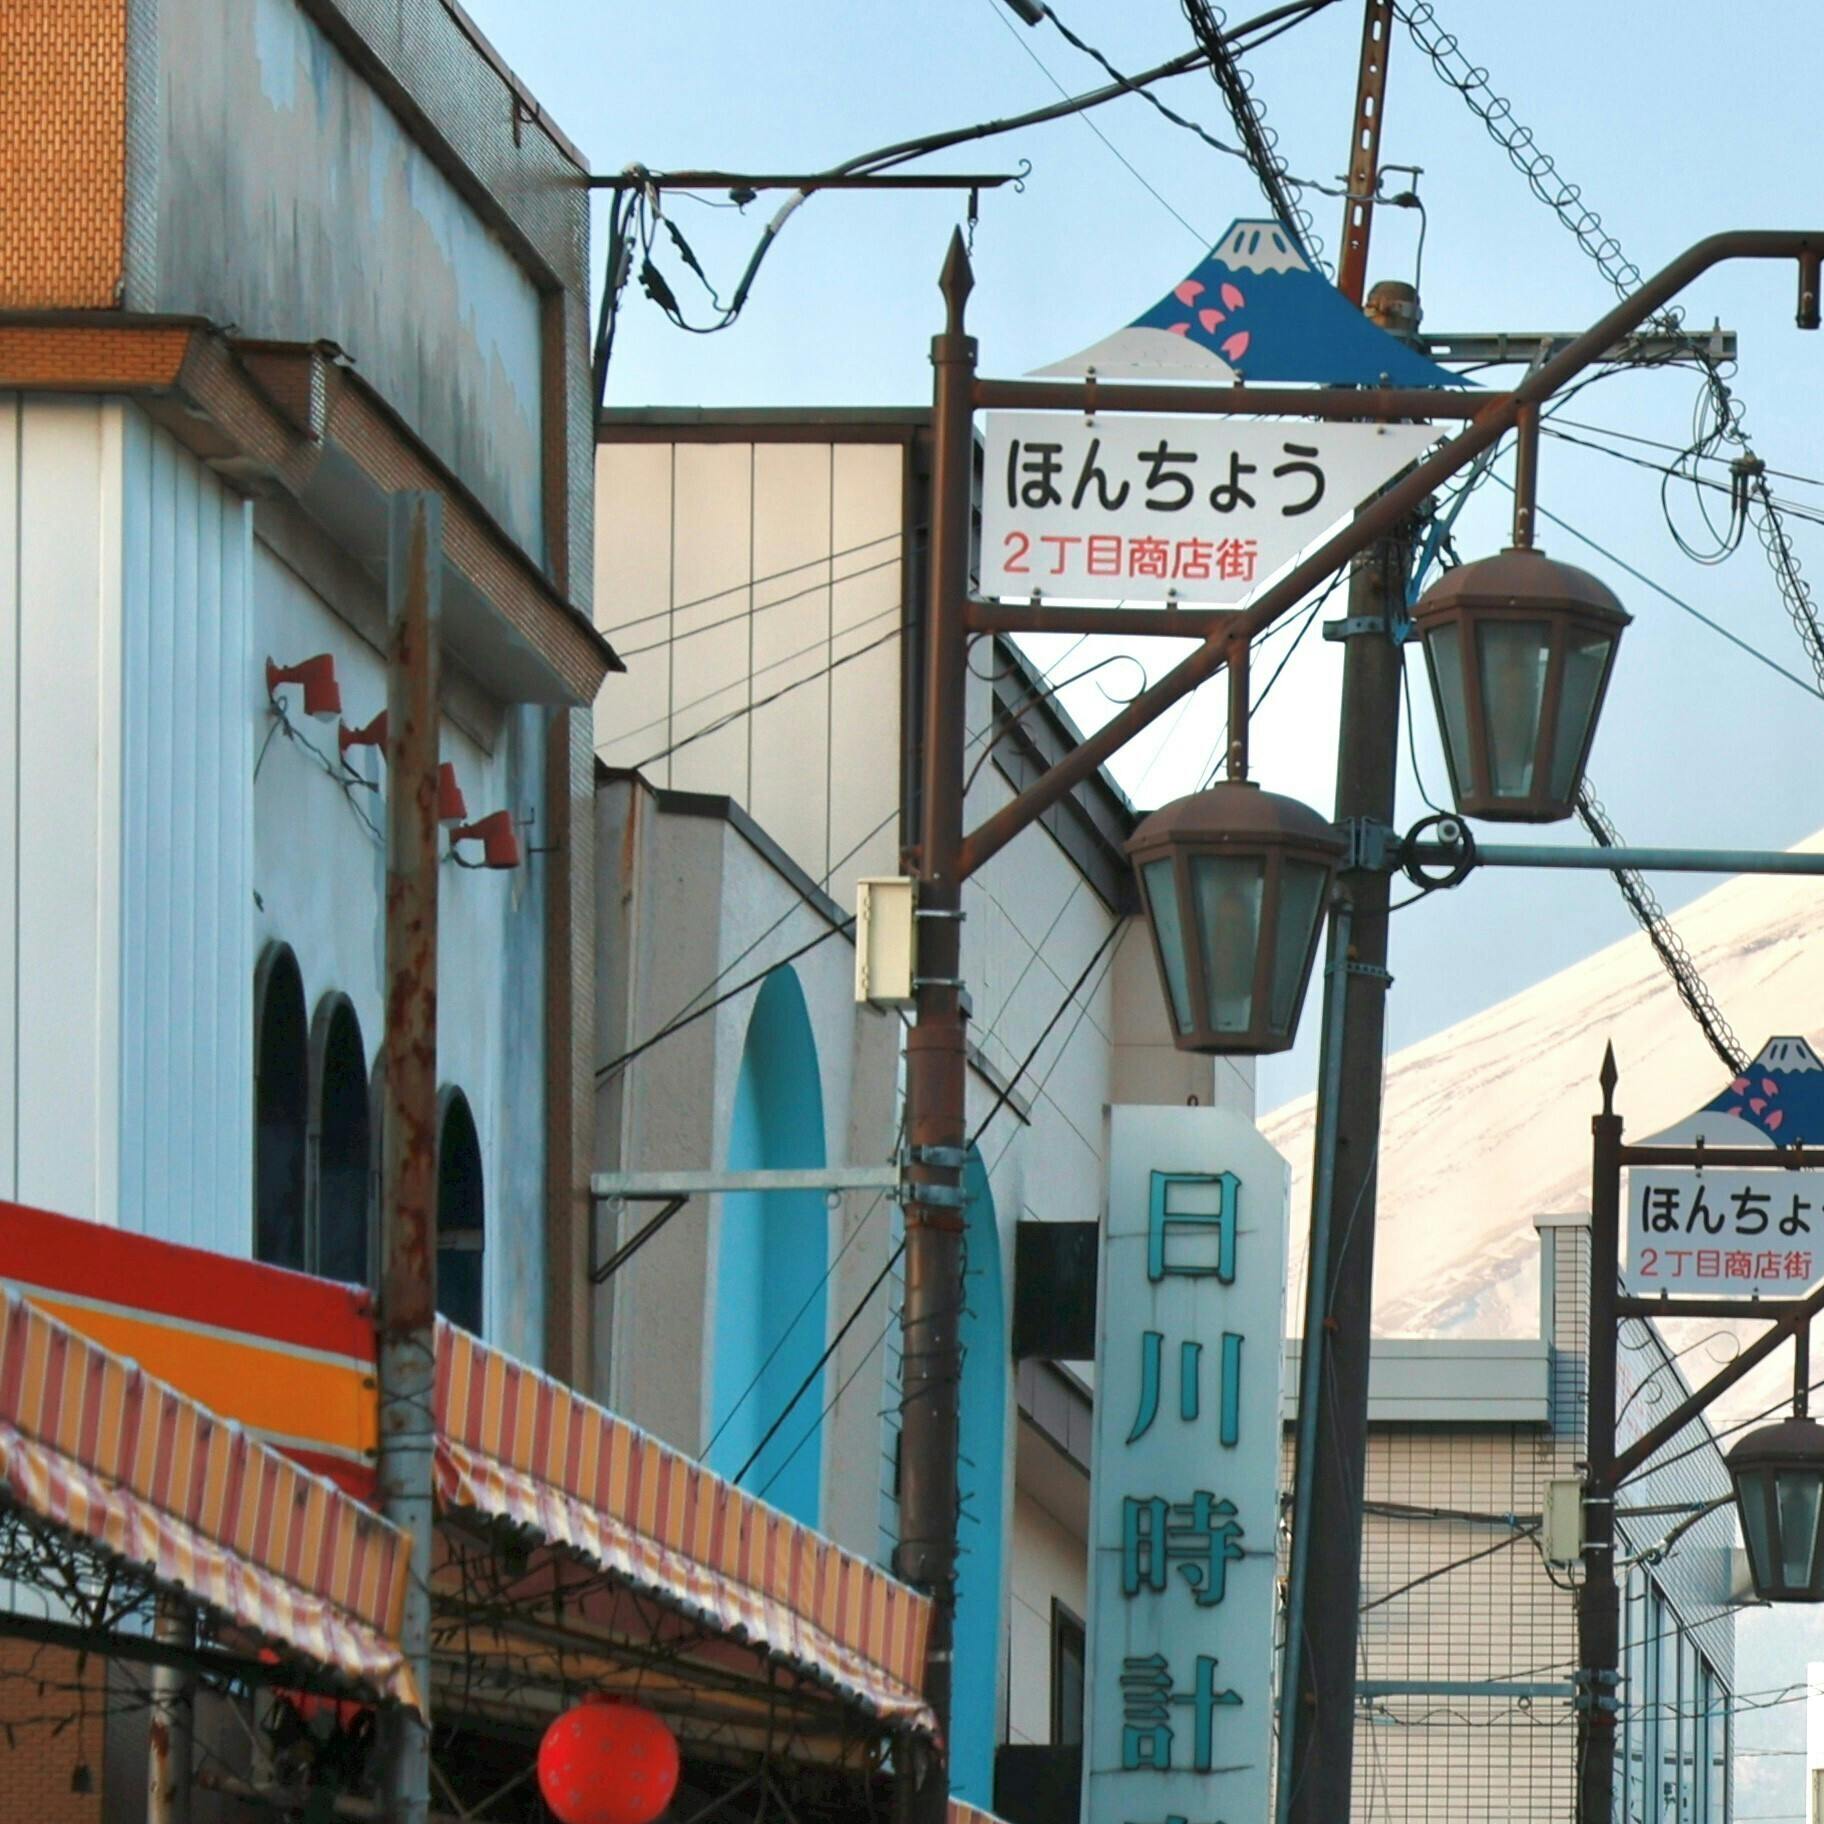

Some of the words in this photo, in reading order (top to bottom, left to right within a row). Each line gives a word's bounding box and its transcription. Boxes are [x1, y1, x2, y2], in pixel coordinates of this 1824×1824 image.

[1006, 439, 1326, 516] ほんちょう
[1003, 532, 1258, 582] 2丁目商店街
[1638, 1248, 1813, 1281] 2丁目商店街
